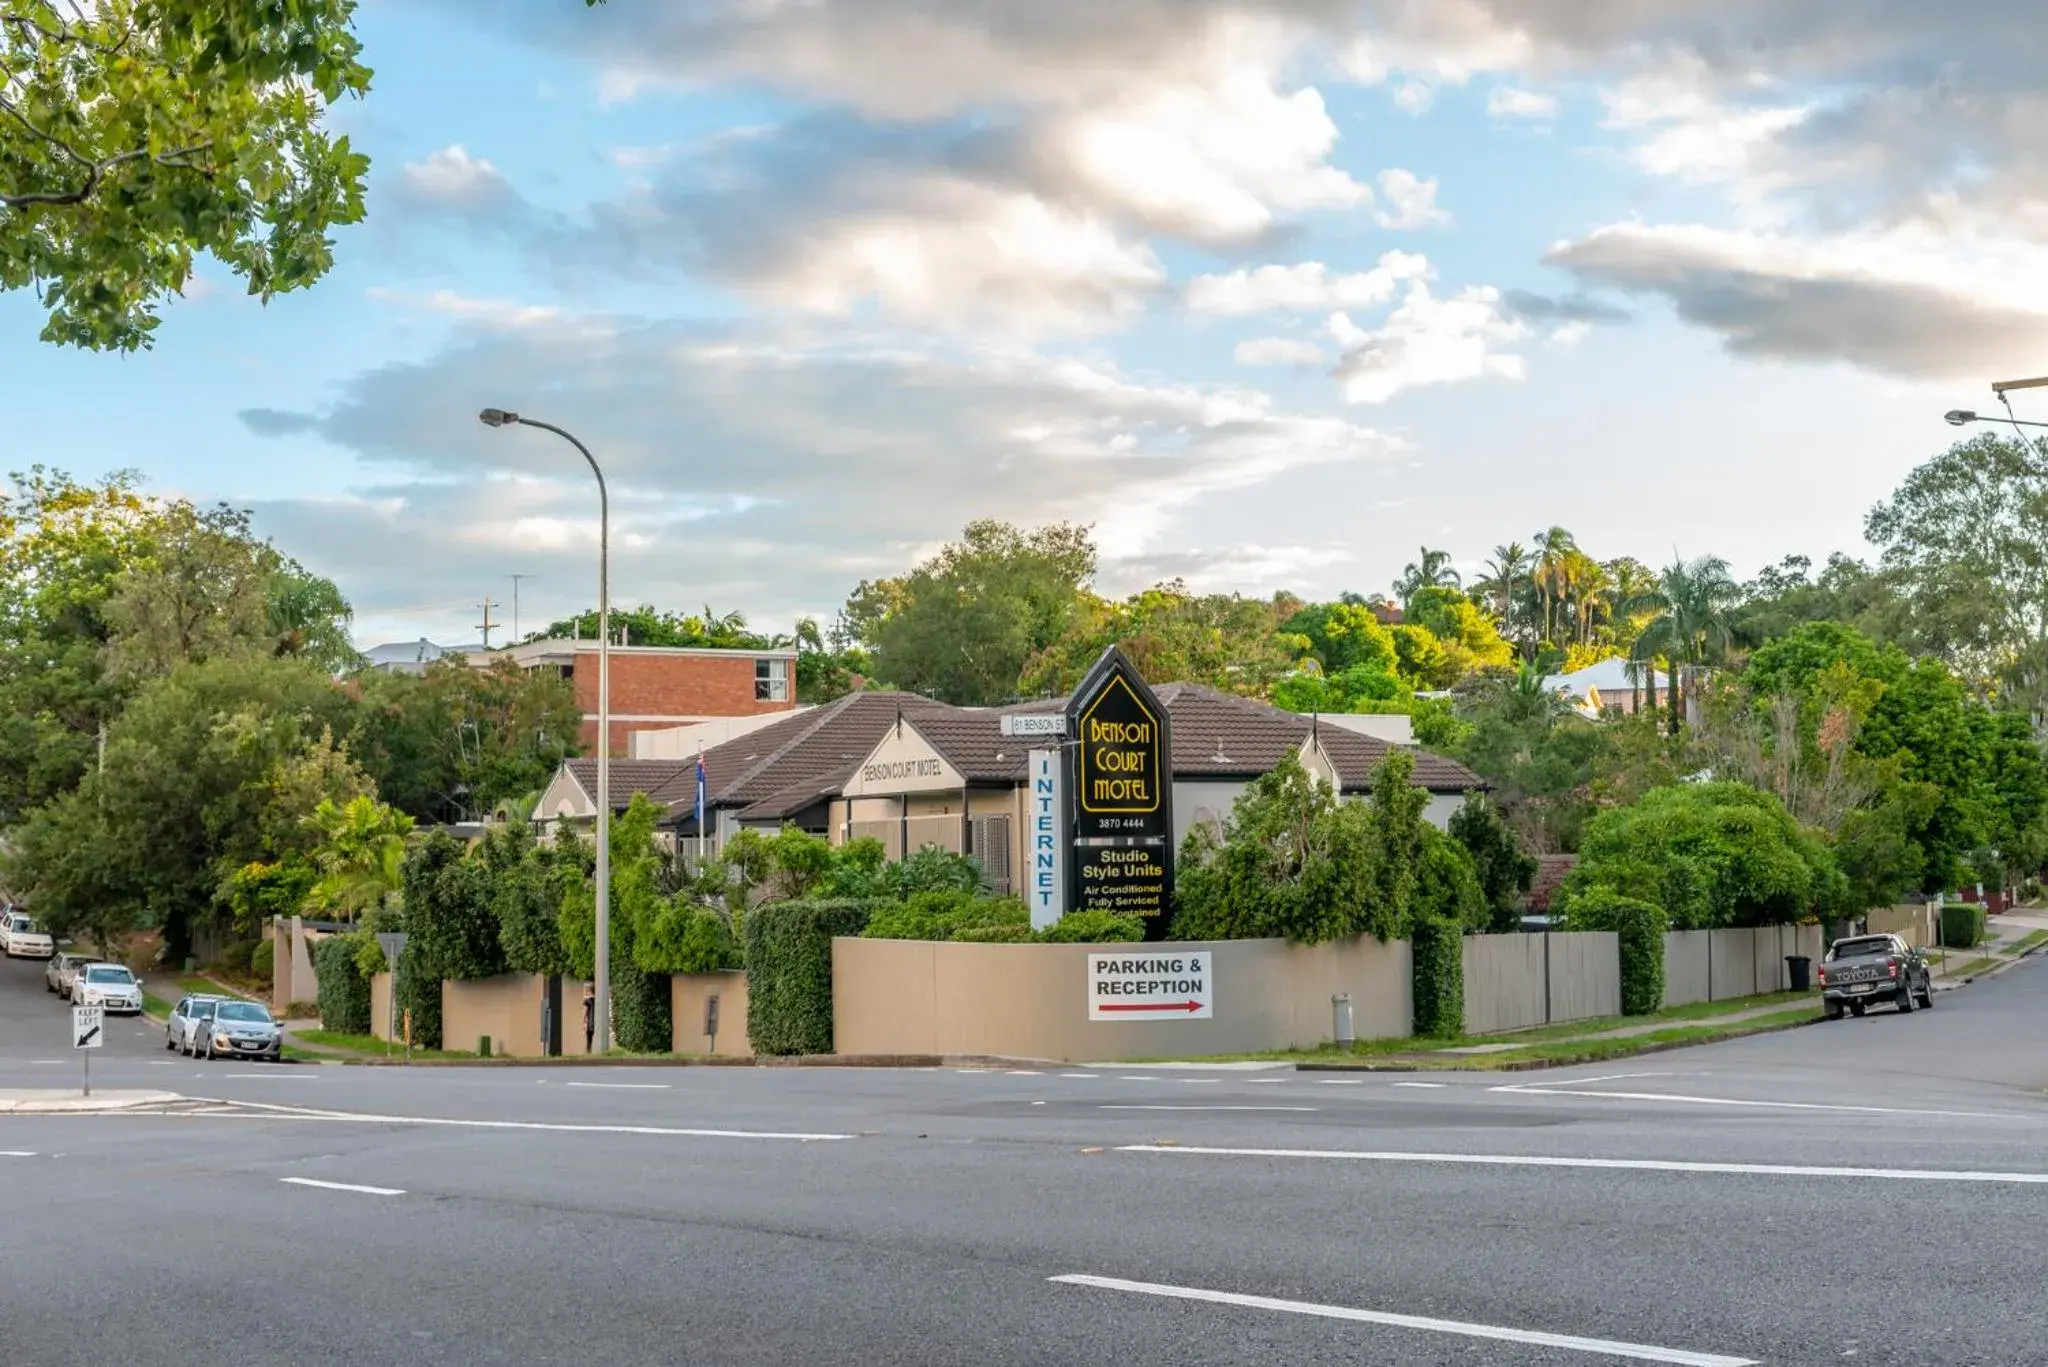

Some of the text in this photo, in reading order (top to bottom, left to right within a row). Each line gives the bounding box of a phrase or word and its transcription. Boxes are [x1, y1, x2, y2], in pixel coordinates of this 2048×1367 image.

[1024, 719, 1053, 730] BENSON
[864, 759, 941, 781] BENSON COURT MOTEL
[1094, 779, 1150, 800] MOTEL
[1099, 818, 1144, 829] 3870 4444
[1037, 760, 1053, 906] INTERNET
[1101, 849, 1149, 863] Studio
[1083, 864, 1163, 880] Style Units
[1084, 884, 1162, 895] Air Conditioned
[1088, 896, 1160, 907] Fully Serviced
[1097, 959, 1202, 974] PARKING &
[1835, 969, 1879, 980] TOYOTA
[1097, 980, 1202, 995] RECEPTION
